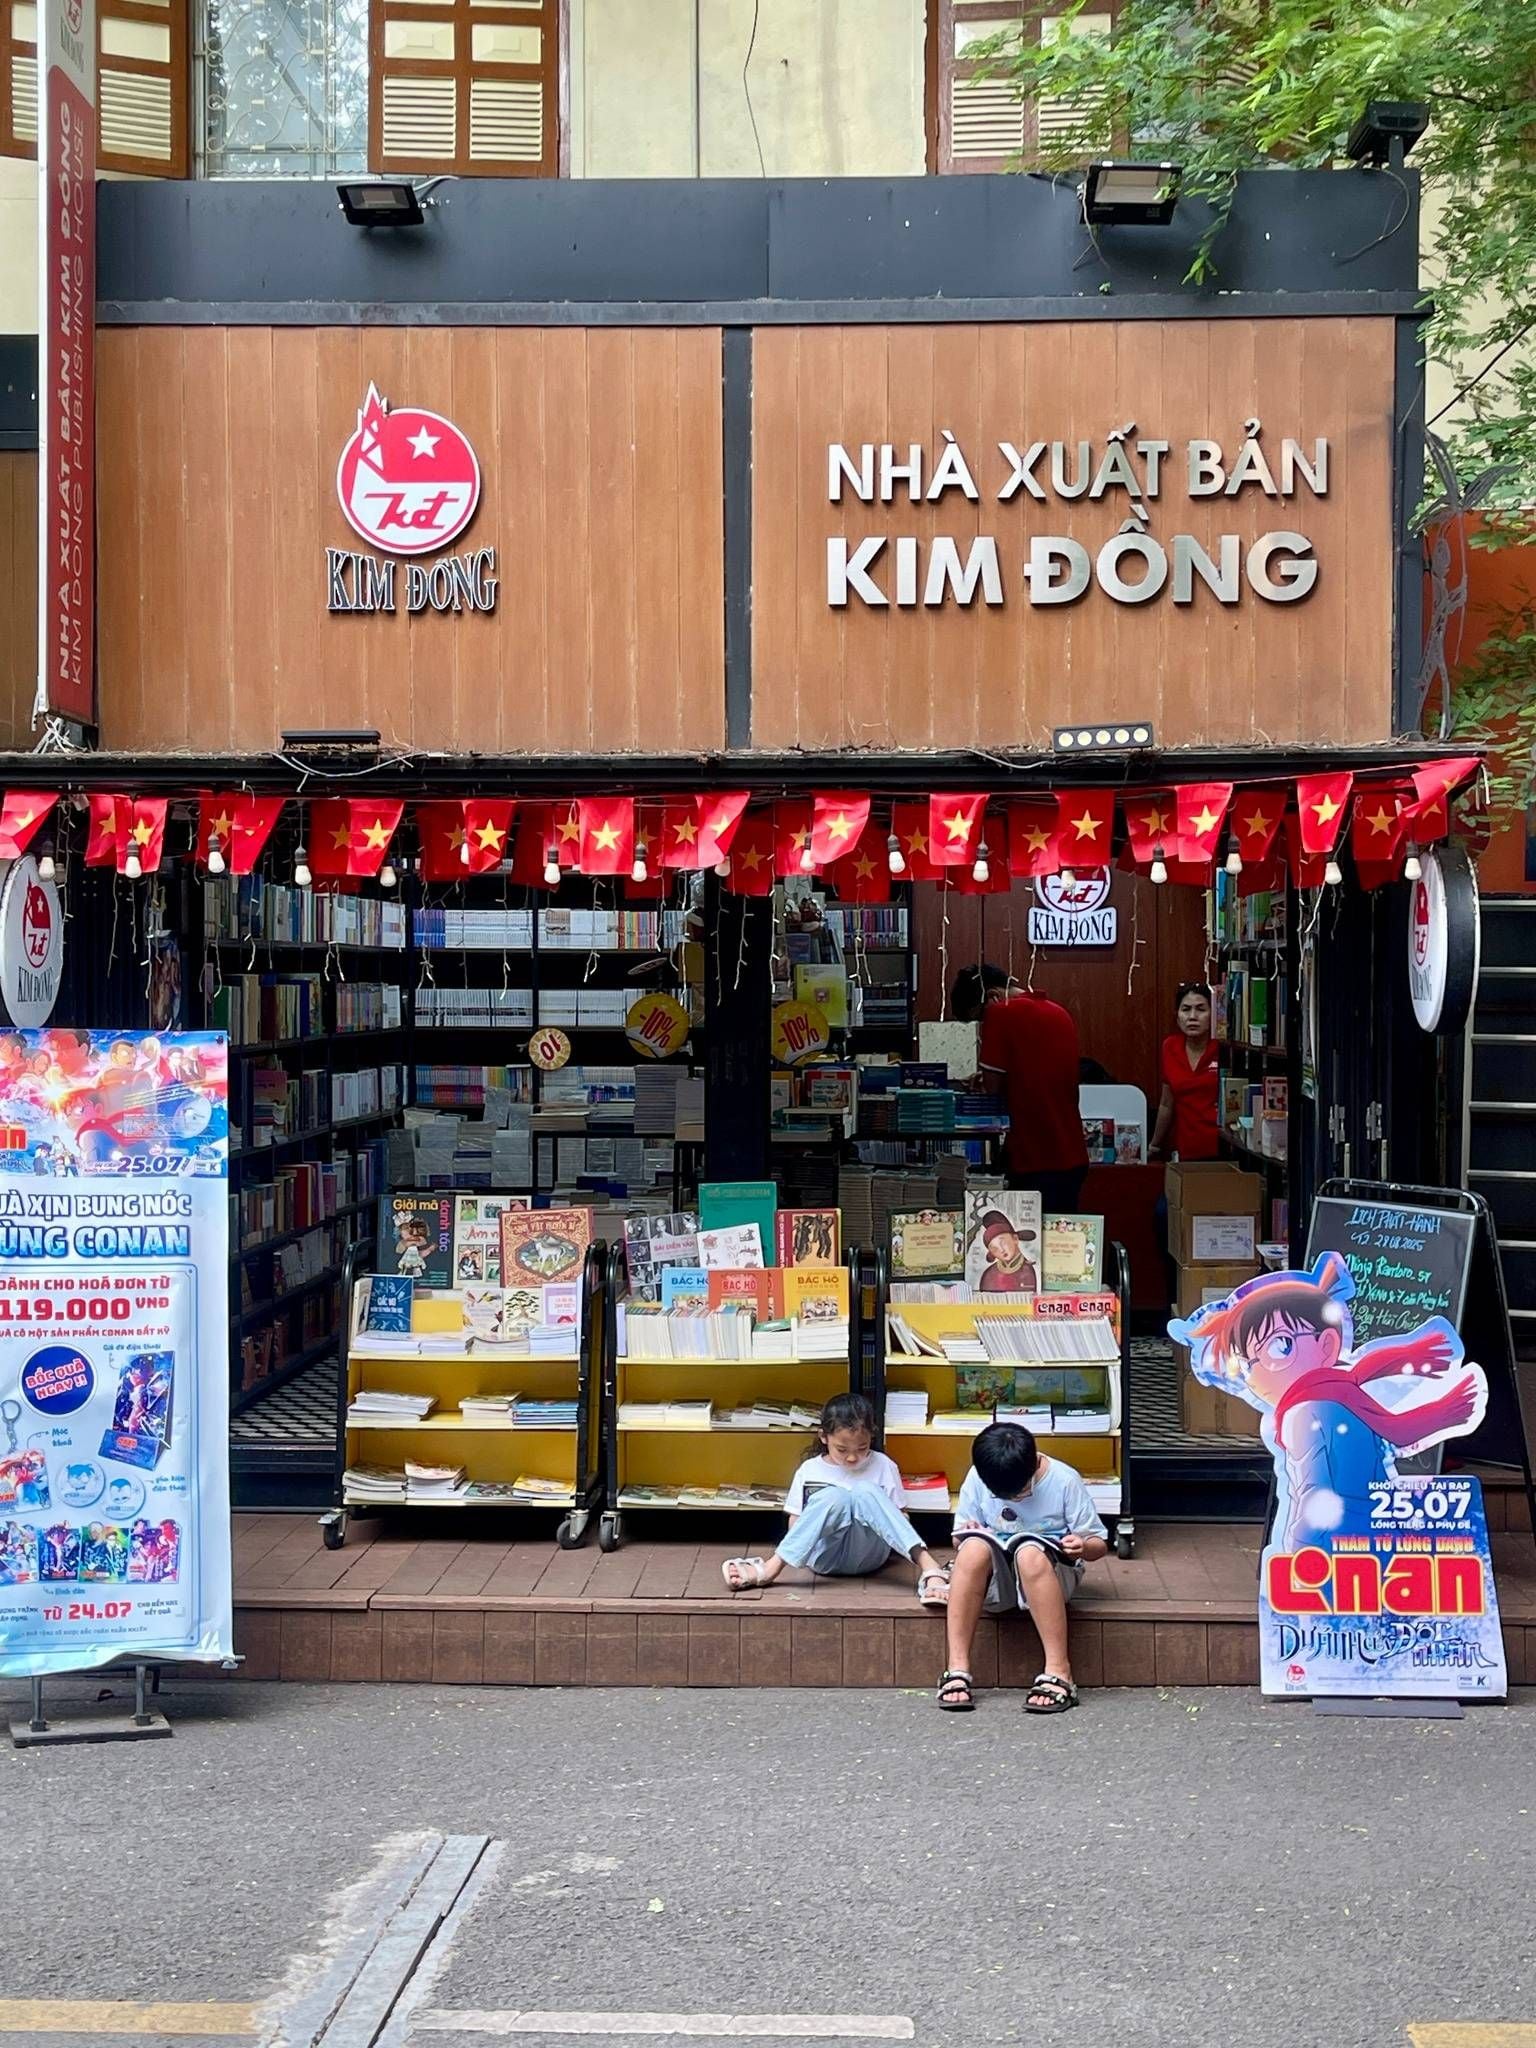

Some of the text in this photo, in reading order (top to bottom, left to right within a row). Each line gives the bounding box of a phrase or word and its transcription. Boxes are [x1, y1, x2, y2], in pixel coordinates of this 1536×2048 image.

[60, 254, 72, 338] KIM
[71, 118, 84, 685] KIM DONG PUBLISHING HOUSE
[827, 417, 1329, 501] NHÀ XUẤT BẢN
[826, 504, 1319, 607] KIM ĐỒNG
[325, 546, 497, 612] KIM ĐỒNG
[1033, 911, 1065, 941] KIM
[17, 966, 33, 1002] KIM
[639, 1007, 679, 1049] -10%
[777, 1013, 821, 1053] -10%
[117, 1156, 183, 1173] 25.07
[28, 1194, 71, 1221] XỊN
[75, 1194, 140, 1216] BUNG
[144, 1190, 192, 1216] NÓC
[74, 1225, 191, 1258] CONAN
[44, 1279, 75, 1290] CHO
[114, 1276, 146, 1290] ĐƠN
[671, 1275, 696, 1285] BÁC
[722, 1278, 743, 1290] BÁC
[797, 1274, 820, 1285] BÁC
[0, 1296, 169, 1321] 119.000 VNĐ
[102, 1328, 134, 1337] CONAN
[35, 1380, 73, 1400] NGAY
[1368, 1479, 1396, 1490] KHỞI
[1429, 1481, 1447, 1493] TẠI
[1448, 1481, 1471, 1493] RẠP
[1368, 1490, 1472, 1519] 25.07
[1426, 1521, 1434, 1529] &
[68, 1602, 132, 1620] 24.07
[1477, 1675, 1487, 1686] K
